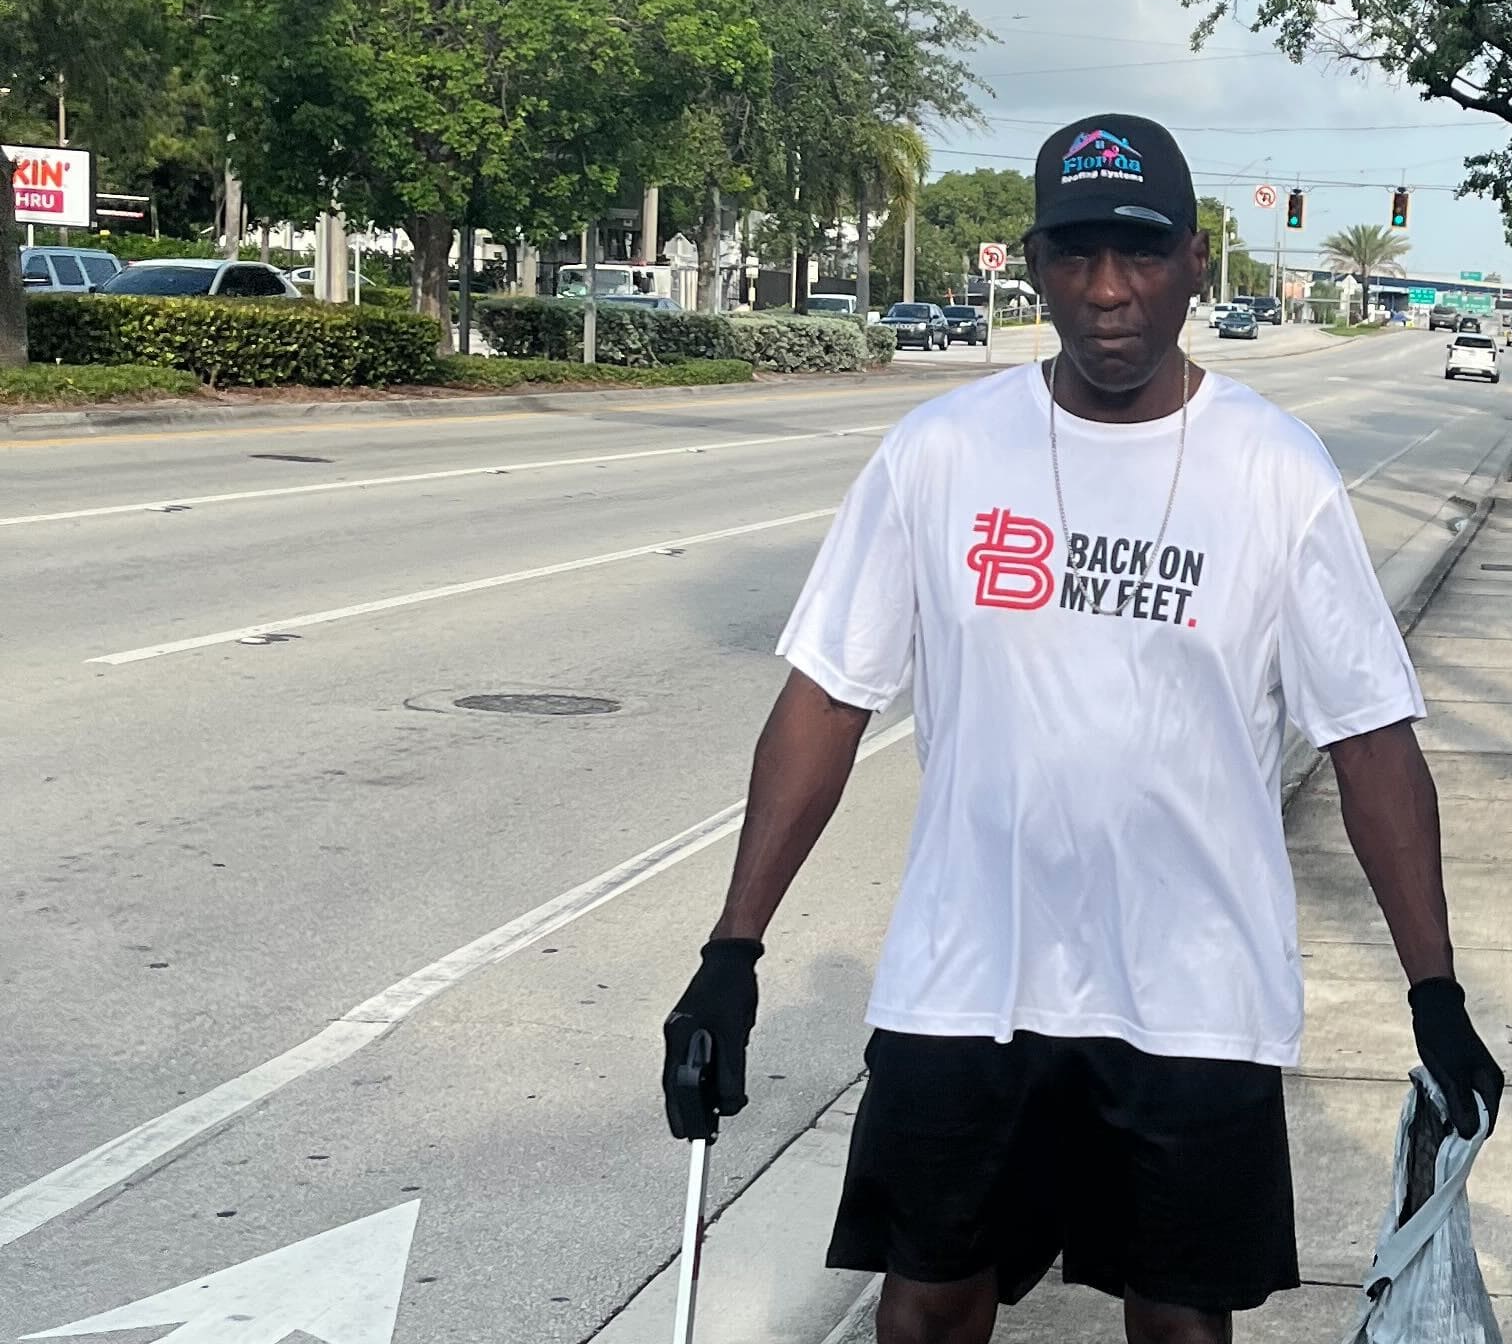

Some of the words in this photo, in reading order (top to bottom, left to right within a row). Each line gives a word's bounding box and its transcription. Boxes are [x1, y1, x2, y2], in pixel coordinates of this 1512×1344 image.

[1066, 532, 1153, 576] BACK
[1159, 545, 1205, 587] ON
[1059, 572, 1112, 615] MY
[1115, 579, 1197, 628] FEET.
